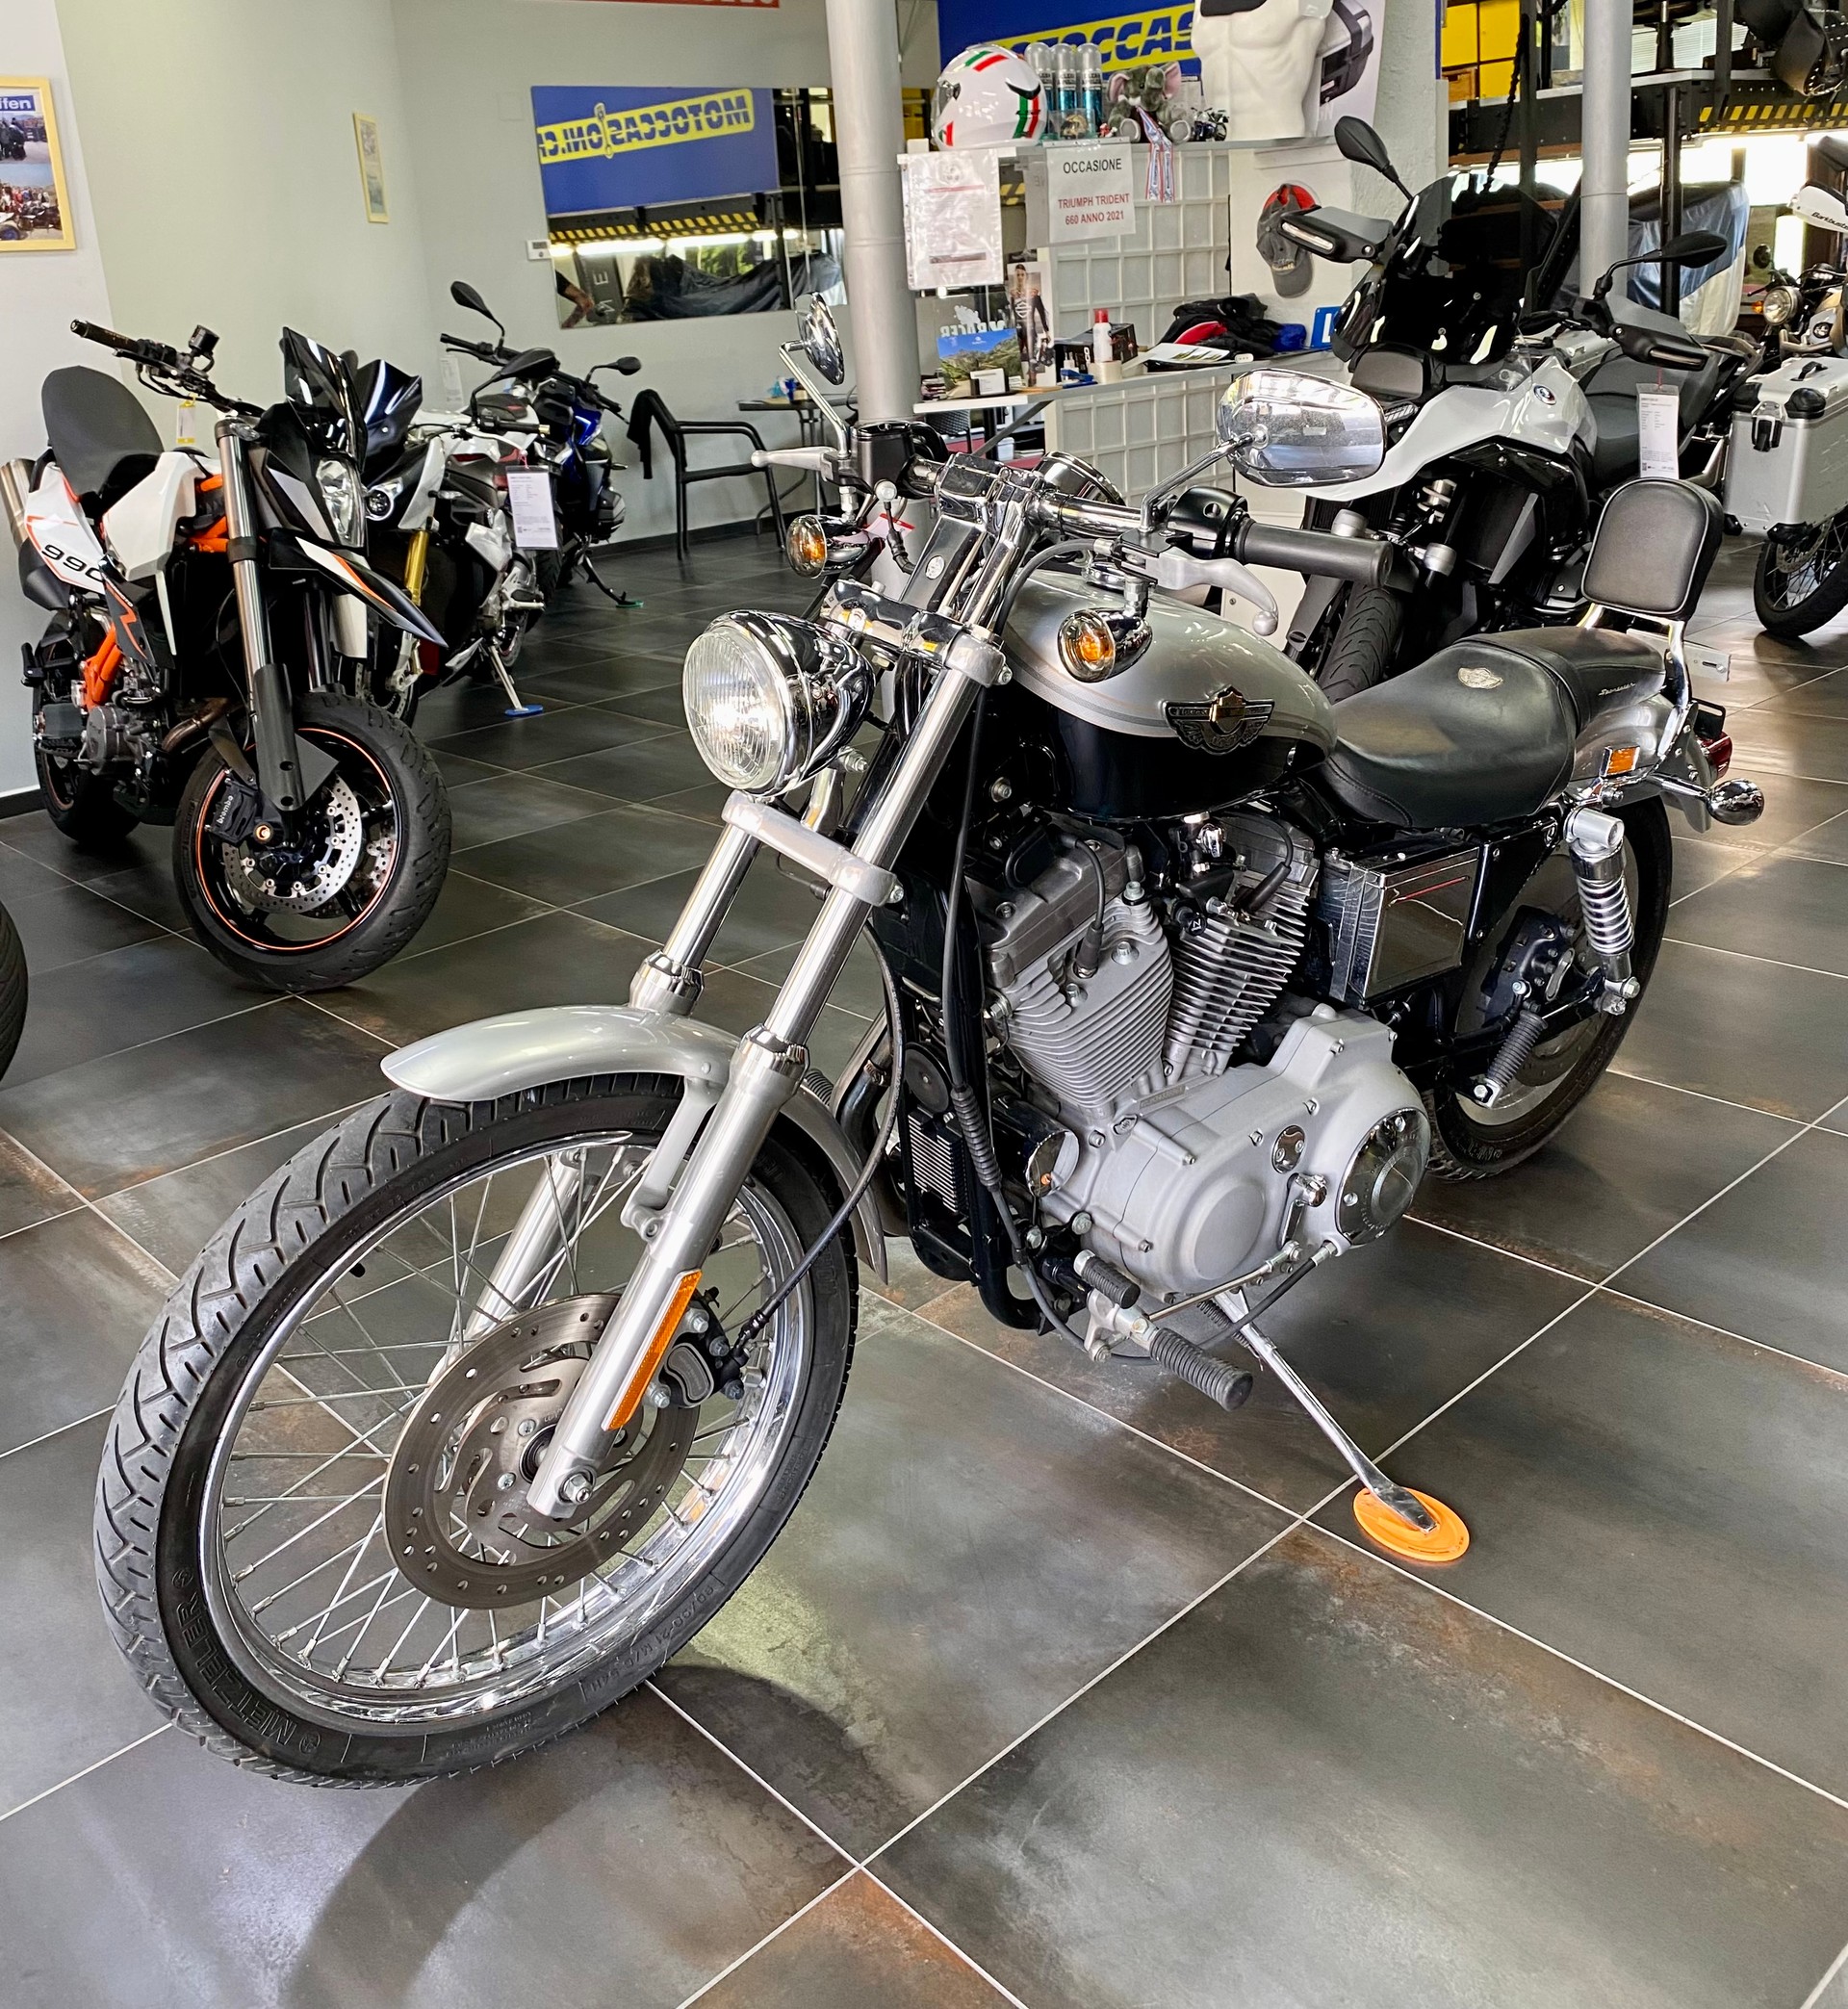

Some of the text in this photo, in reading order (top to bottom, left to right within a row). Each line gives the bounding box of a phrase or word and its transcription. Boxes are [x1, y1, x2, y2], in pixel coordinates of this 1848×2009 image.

[1063, 158, 1122, 174] OCCASIONE
[1058, 193, 1130, 209] TRIUMPH TRIDENT
[1065, 211, 1124, 225] 660 ANNO 2021
[217, 795, 234, 824] brembo
[177, 1591, 297, 1745] METZELER
